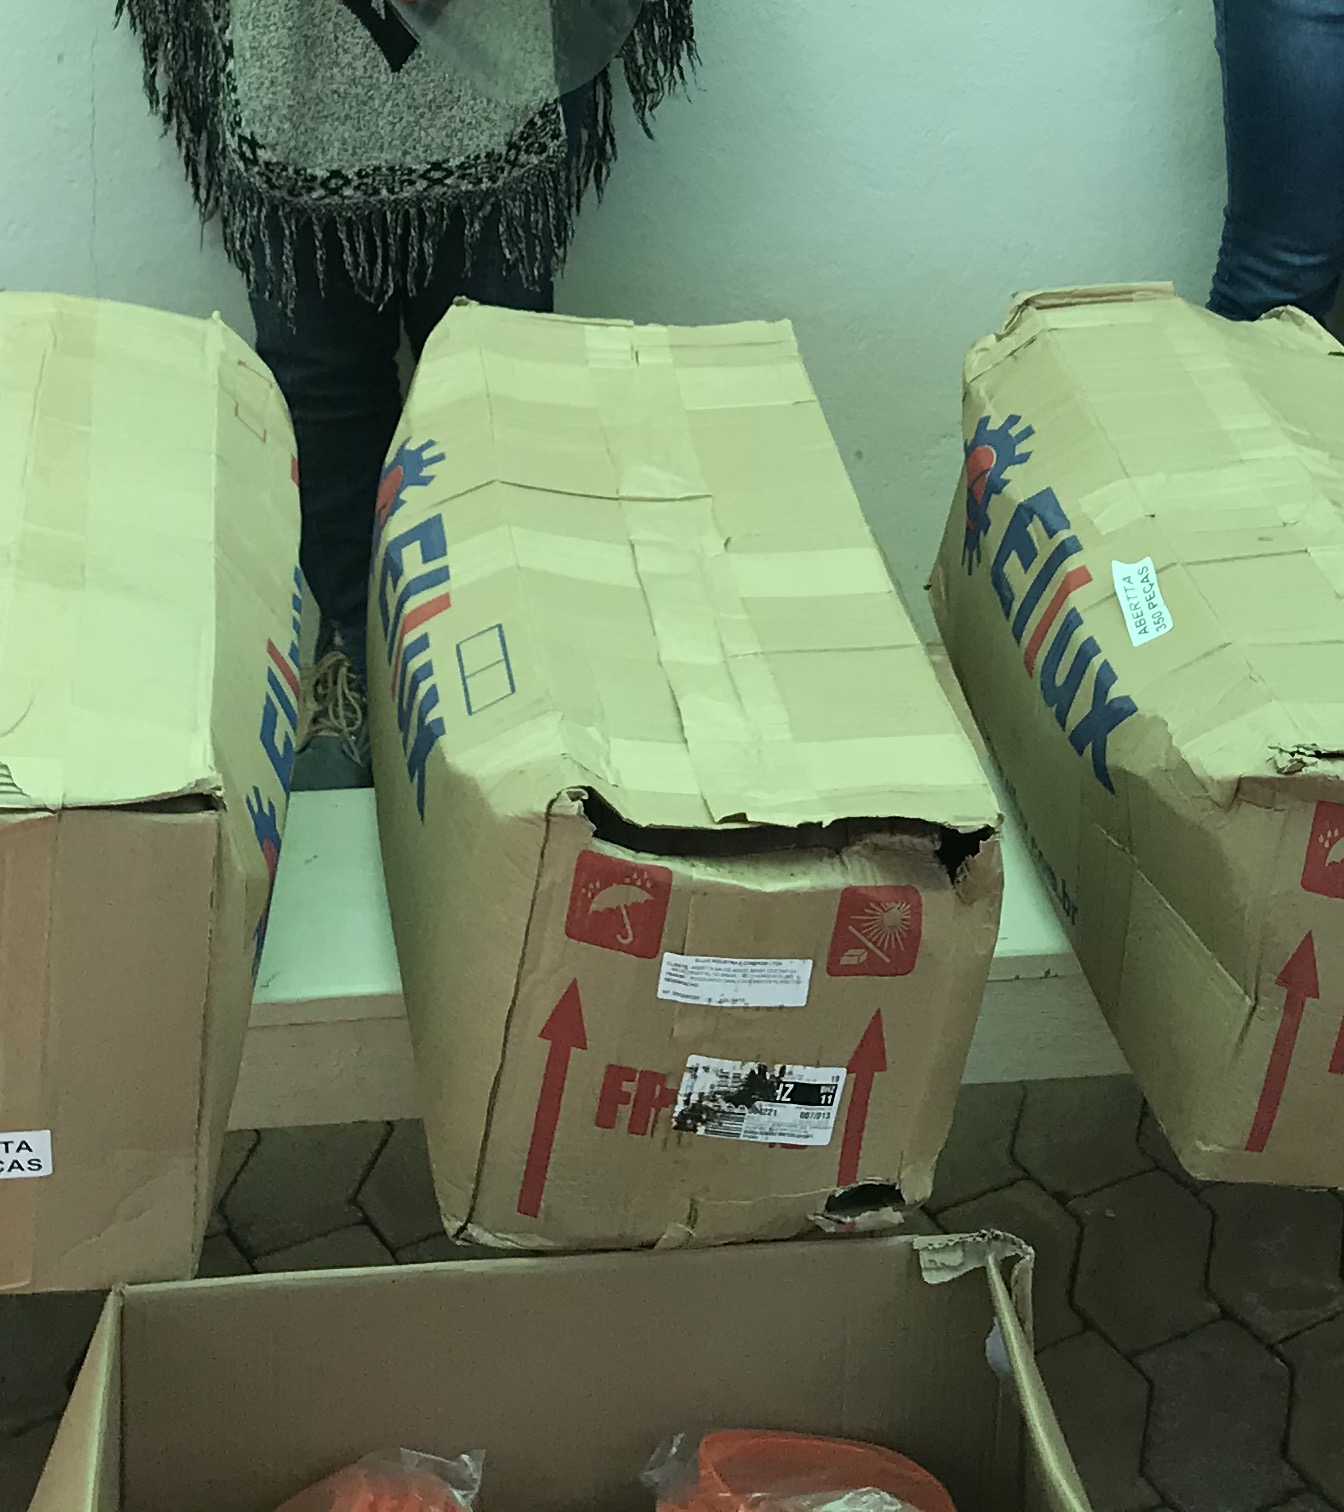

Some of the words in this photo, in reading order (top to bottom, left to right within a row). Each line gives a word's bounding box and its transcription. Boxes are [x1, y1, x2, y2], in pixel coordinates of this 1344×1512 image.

[1122, 575, 1149, 635] ABERTTA
[1137, 565, 1158, 610] PEÇAS
[991, 486, 1138, 796] Ellux
[1151, 610, 1167, 632] 350
